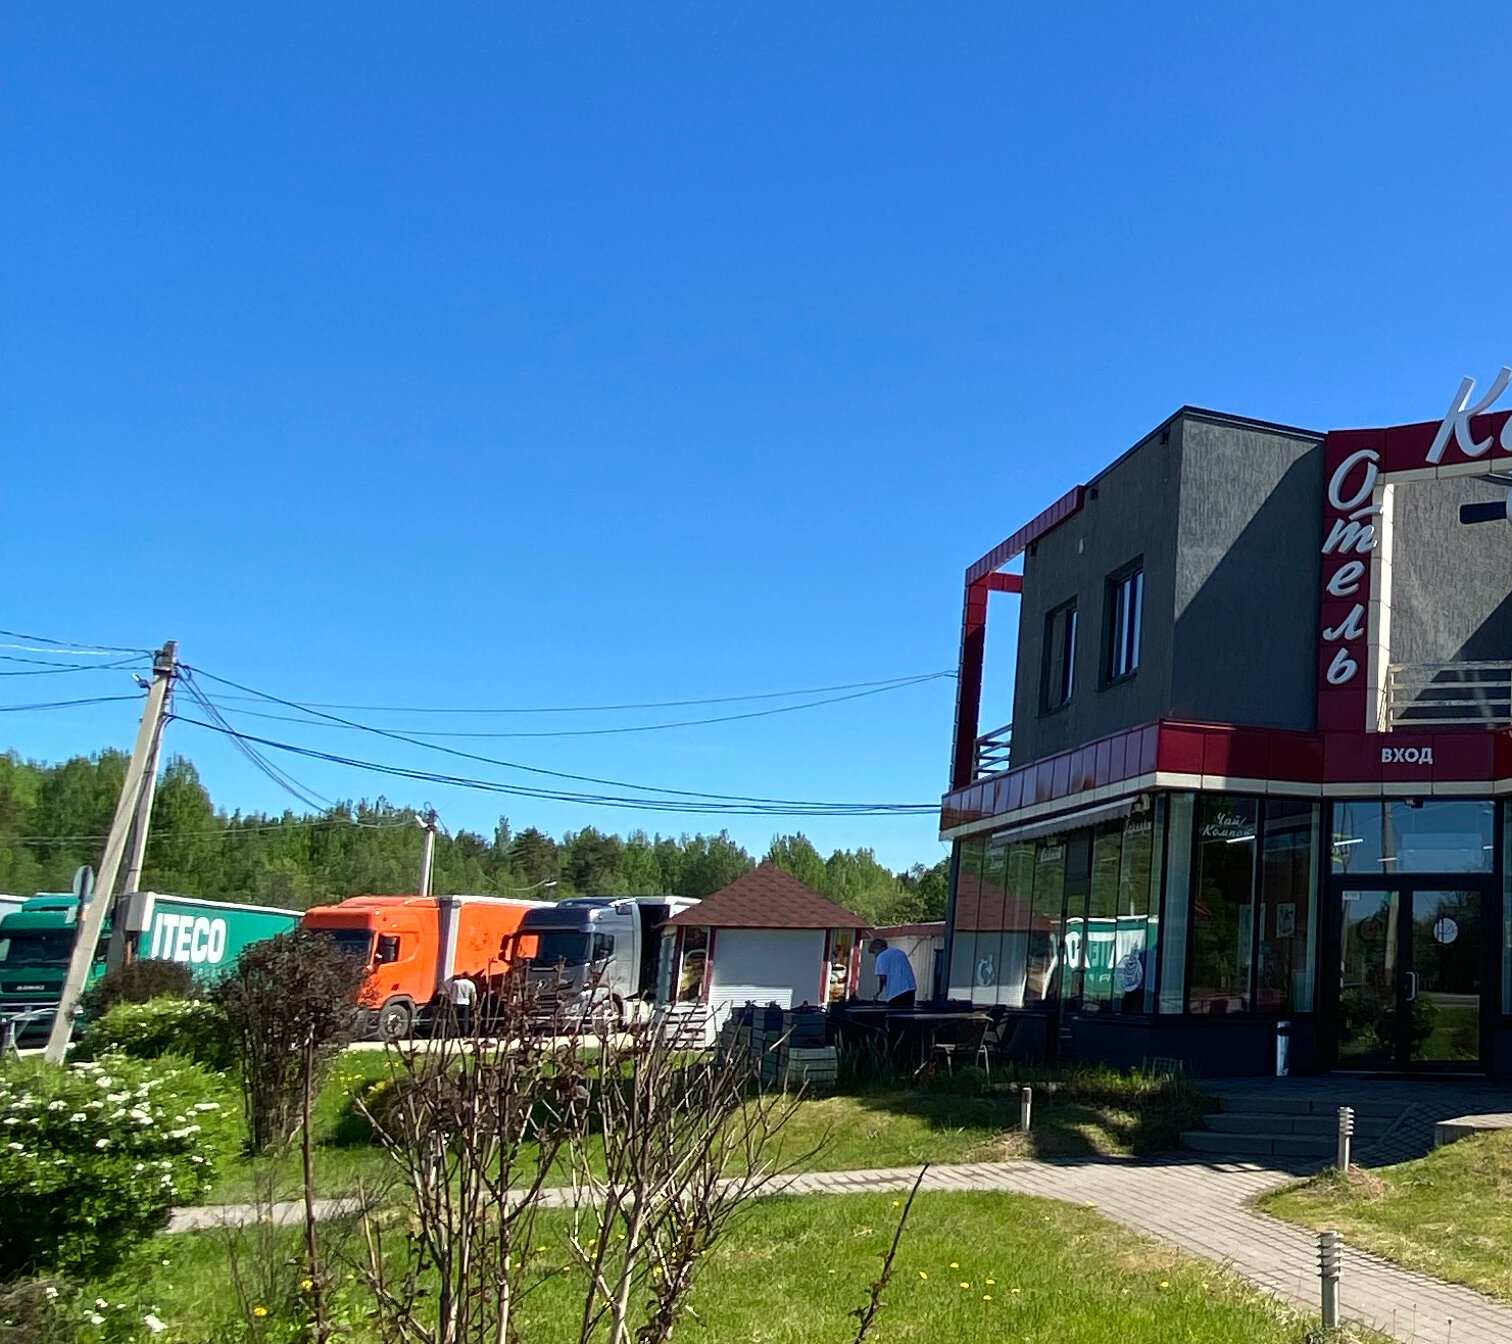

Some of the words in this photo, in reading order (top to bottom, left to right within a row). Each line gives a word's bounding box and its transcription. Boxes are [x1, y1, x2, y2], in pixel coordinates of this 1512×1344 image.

[1321, 449, 1383, 685] Отель
[1381, 747, 1434, 765] ВХОД
[151, 912, 227, 964] ITECO
